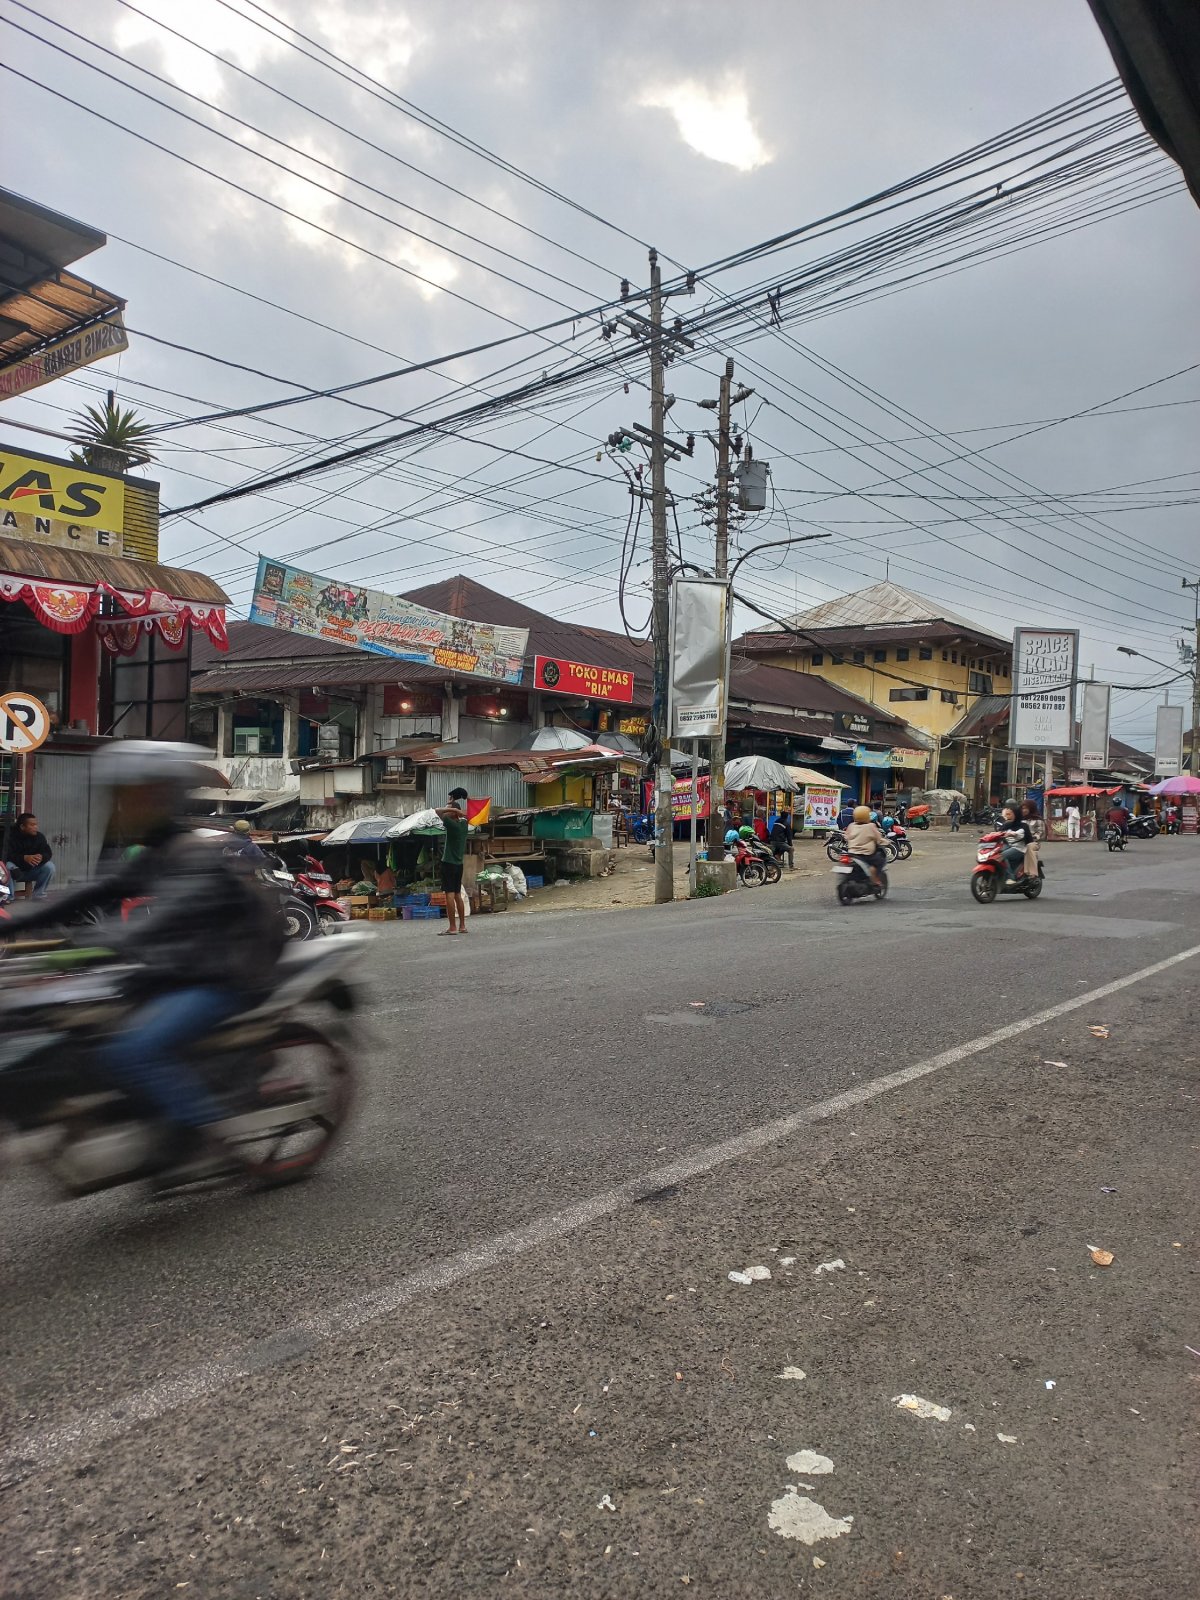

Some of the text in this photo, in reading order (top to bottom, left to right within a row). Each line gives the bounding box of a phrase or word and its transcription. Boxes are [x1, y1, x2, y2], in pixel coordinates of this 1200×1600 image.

[0, 462, 107, 518] AS
[3, 511, 110, 546] ANCE
[389, 622, 418, 640] TAHUN
[418, 627, 446, 643] BARU
[1025, 636, 1069, 655] SPACE
[569, 664, 629, 686] TOKO EMAS
[1024, 654, 1069, 675] IKLAN
[1022, 674, 1068, 687] DISEWAKAN
